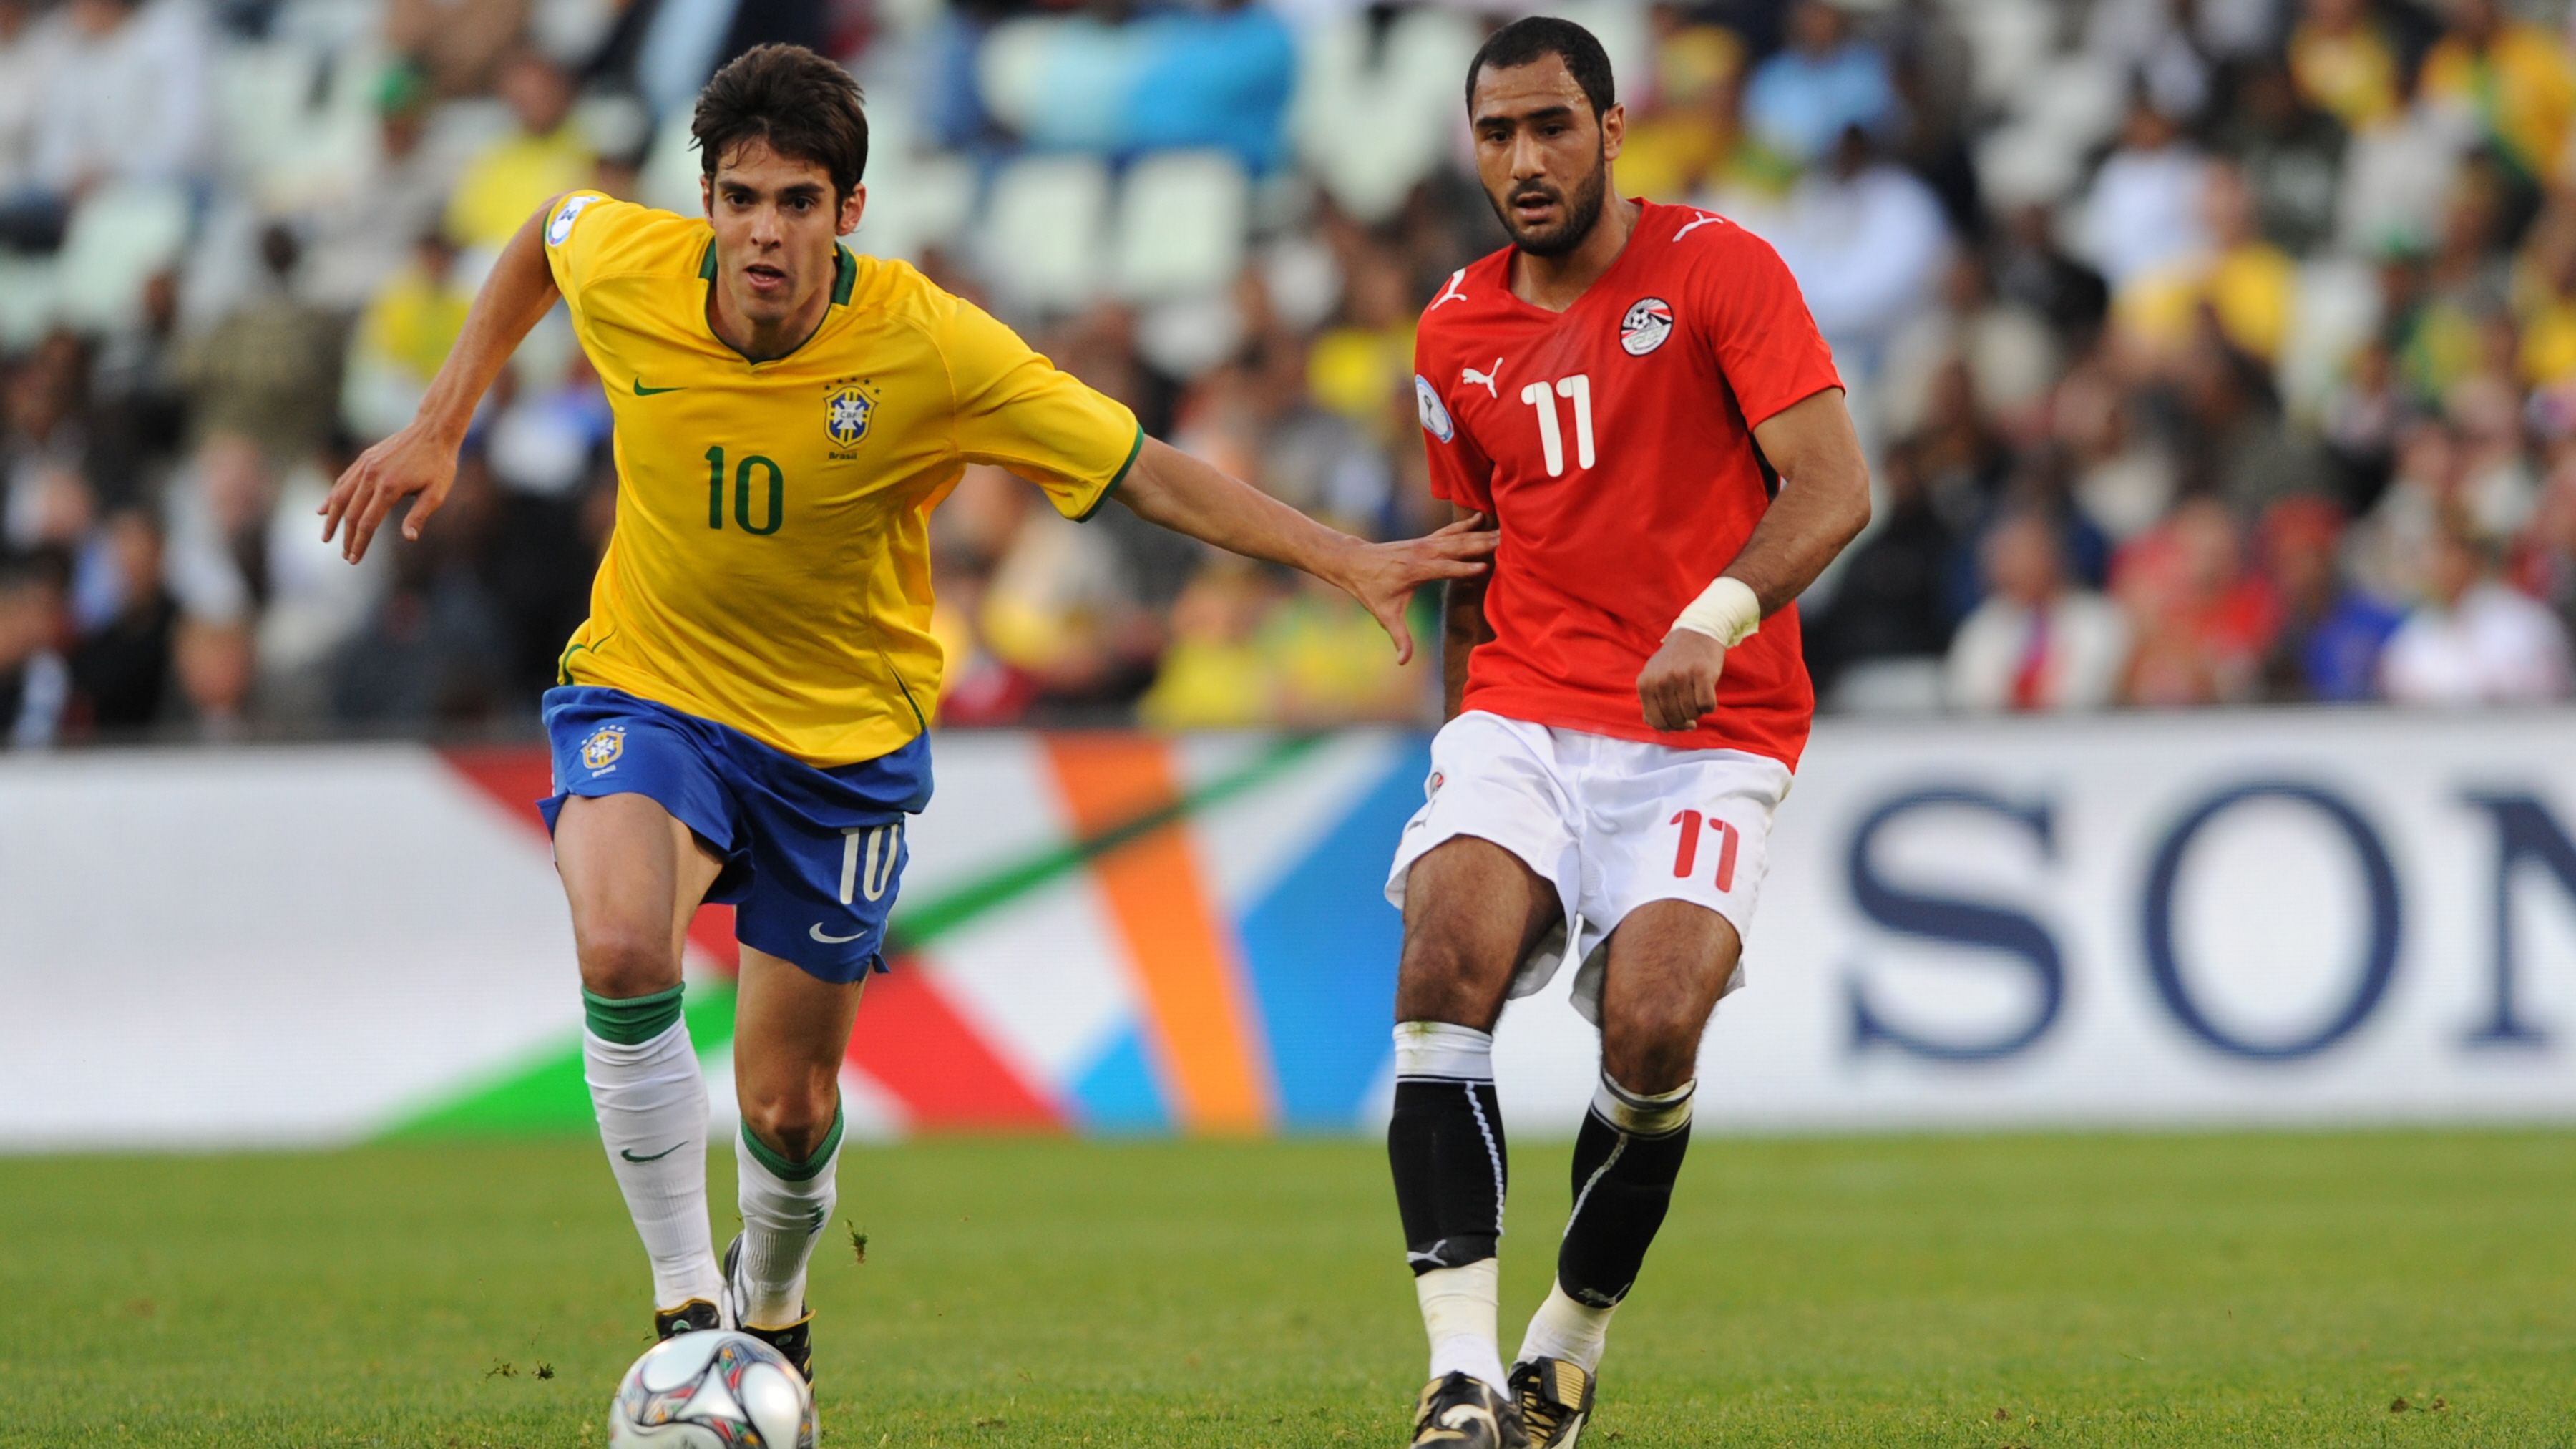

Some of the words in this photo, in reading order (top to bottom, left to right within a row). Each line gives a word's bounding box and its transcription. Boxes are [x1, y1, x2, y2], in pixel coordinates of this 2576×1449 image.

[1521, 374, 1596, 477] 11
[705, 446, 784, 535] 10
[839, 824, 899, 904] 10
[1669, 809, 1739, 894] 11
